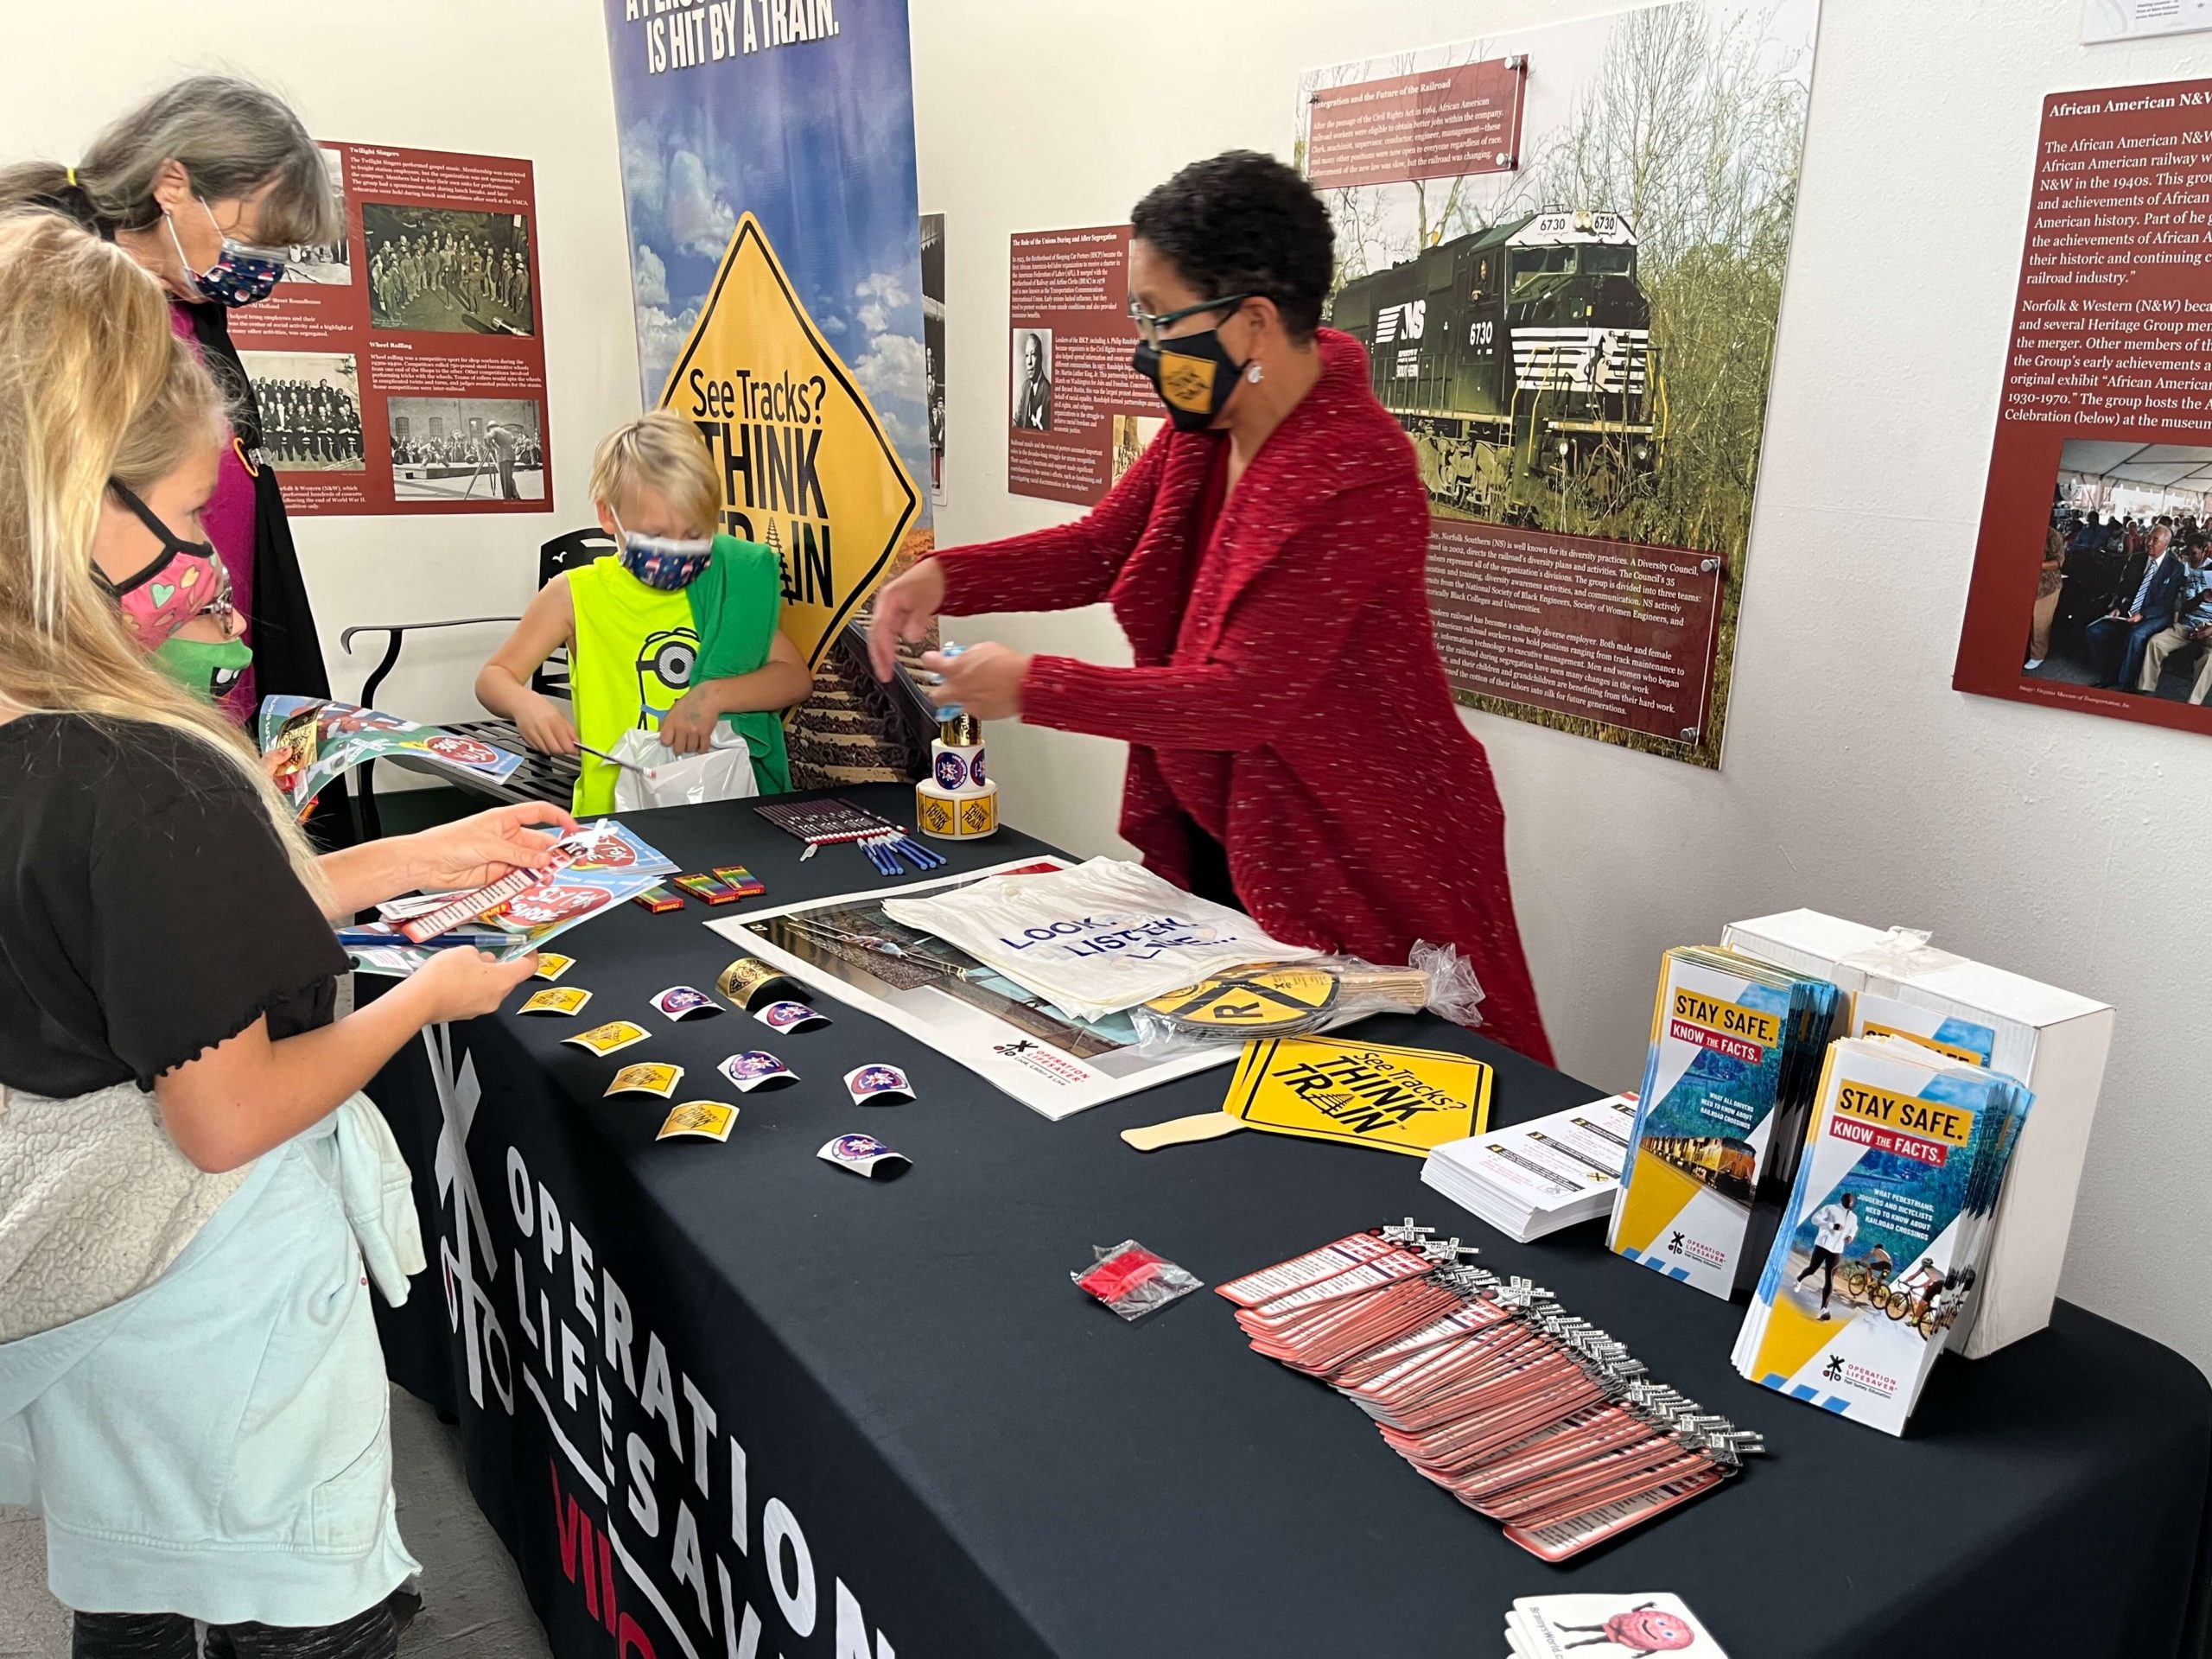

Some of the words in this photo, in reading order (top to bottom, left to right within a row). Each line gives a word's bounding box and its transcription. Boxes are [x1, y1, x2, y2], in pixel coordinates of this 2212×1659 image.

[646, 18, 667, 73] IS
[669, 9, 705, 69] HIT
[709, 0, 736, 60] BY
[743, 0, 758, 54] A
[760, 0, 840, 48] TRAIN.
[1313, 97, 1350, 110] Integration
[1351, 93, 1363, 103] and
[1364, 92, 1375, 101] the
[1376, 90, 1398, 99] Future
[1399, 86, 1407, 95] of
[1421, 79, 1451, 92] Railroad
[2050, 103, 2101, 117] African
[2104, 96, 2175, 112] American
[2045, 142, 2067, 153] The
[2069, 138, 2113, 152] African
[2117, 134, 2177, 149] American
[2042, 158, 2085, 172] African
[2088, 156, 2146, 169] American
[2151, 152, 2197, 167] railway
[2040, 178, 2073, 190] N&W
[2075, 177, 2087, 189] in
[2090, 176, 2109, 188] the
[2113, 177, 2152, 189] 1940s.
[2156, 172, 2183, 186] This
[2037, 197, 2059, 209] and
[2062, 194, 2144, 209] achievements
[2146, 193, 2162, 205] of
[2162, 192, 2209, 205] African
[1540, 218, 1566, 231] 6730
[1593, 216, 1615, 230] 6730
[2035, 214, 2090, 228] American
[2094, 214, 2140, 228] history.
[2144, 213, 2171, 225] Part
[2173, 211, 2190, 224] of
[2190, 210, 2205, 223] he
[1057, 236, 1071, 245] During
[1091, 233, 1117, 242] Segregation
[2033, 235, 2051, 247] the
[2053, 232, 2135, 247] achievements
[2137, 232, 2152, 244] of
[2152, 231, 2200, 244] African
[2030, 253, 2057, 266] their
[2060, 252, 2105, 265] historic
[2107, 251, 2130, 264] and
[2133, 251, 2202, 266] continuing
[2027, 271, 2072, 283] railroad
[1470, 321, 1493, 346] 6730
[690, 368, 734, 418] See
[736, 369, 827, 425] Tracks?
[693, 420, 829, 519] THINK
[1442, 533, 1464, 543] Norfolk
[1464, 535, 1491, 546] Southern
[1491, 538, 1507, 550] (NS)
[1513, 543, 1526, 551] well
[1527, 543, 1548, 554] known
[1549, 546, 1559, 556] for
[1568, 549, 1596, 562] diversity
[1598, 555, 1629, 565] practices.
[1637, 559, 1669, 571] Diversity
[1669, 563, 1699, 576] Council,
[1001, 917, 1118, 950] LOOK.
[1063, 917, 1199, 957] LISTEN.
[1213, 1001, 1263, 1019] R
[1676, 995, 1719, 1023] STAY
[1724, 1009, 1773, 1041] SAFE.
[1673, 1024, 1704, 1044] KNOW
[1706, 1037, 1719, 1048] THE
[1721, 1040, 1758, 1062] FACTS.
[1036, 1051, 1090, 1079] OPERATION
[1314, 1055, 1439, 1122] THINK
[1354, 1052, 1394, 1072] See
[1388, 1069, 1467, 1112] Tracks?
[1272, 1063, 1397, 1135] TRAIN
[1700, 1098, 1713, 1107] NEED
[1720, 1106, 1736, 1115] KNOW
[1736, 1110, 1752, 1121] ABOUT
[1710, 1092, 1723, 1102] WHAT
[1733, 1101, 1754, 1112] DRIVERS
[1700, 1107, 1724, 1120] RAILROAD
[1724, 1116, 1751, 1129] CROSSINGS
[1840, 1088, 1894, 1120] STAY
[1900, 1103, 1963, 1141] SAFE.
[1833, 1121, 1873, 1143] KNOW
[1877, 1135, 1891, 1147] THE
[1894, 1139, 1942, 1163] FACTS.
[1874, 1188, 1891, 1198] WHAT
[1857, 1194, 1884, 1206] JOGGERS
[1885, 1202, 1897, 1211] AND
[1898, 1206, 1932, 1222] BICYCLISTS
[1866, 1206, 1881, 1216] NEED
[1891, 1214, 1910, 1224] KNOW
[1910, 1220, 1931, 1230] ABOUT
[1865, 1216, 1895, 1230] RAILROAD
[1895, 1225, 1929, 1241] CROSSINGS
[1688, 1239, 1725, 1257] OPERATION
[1848, 1363, 1896, 1385] OPERATION
[506, 1146, 895, 1659] OPERATION
